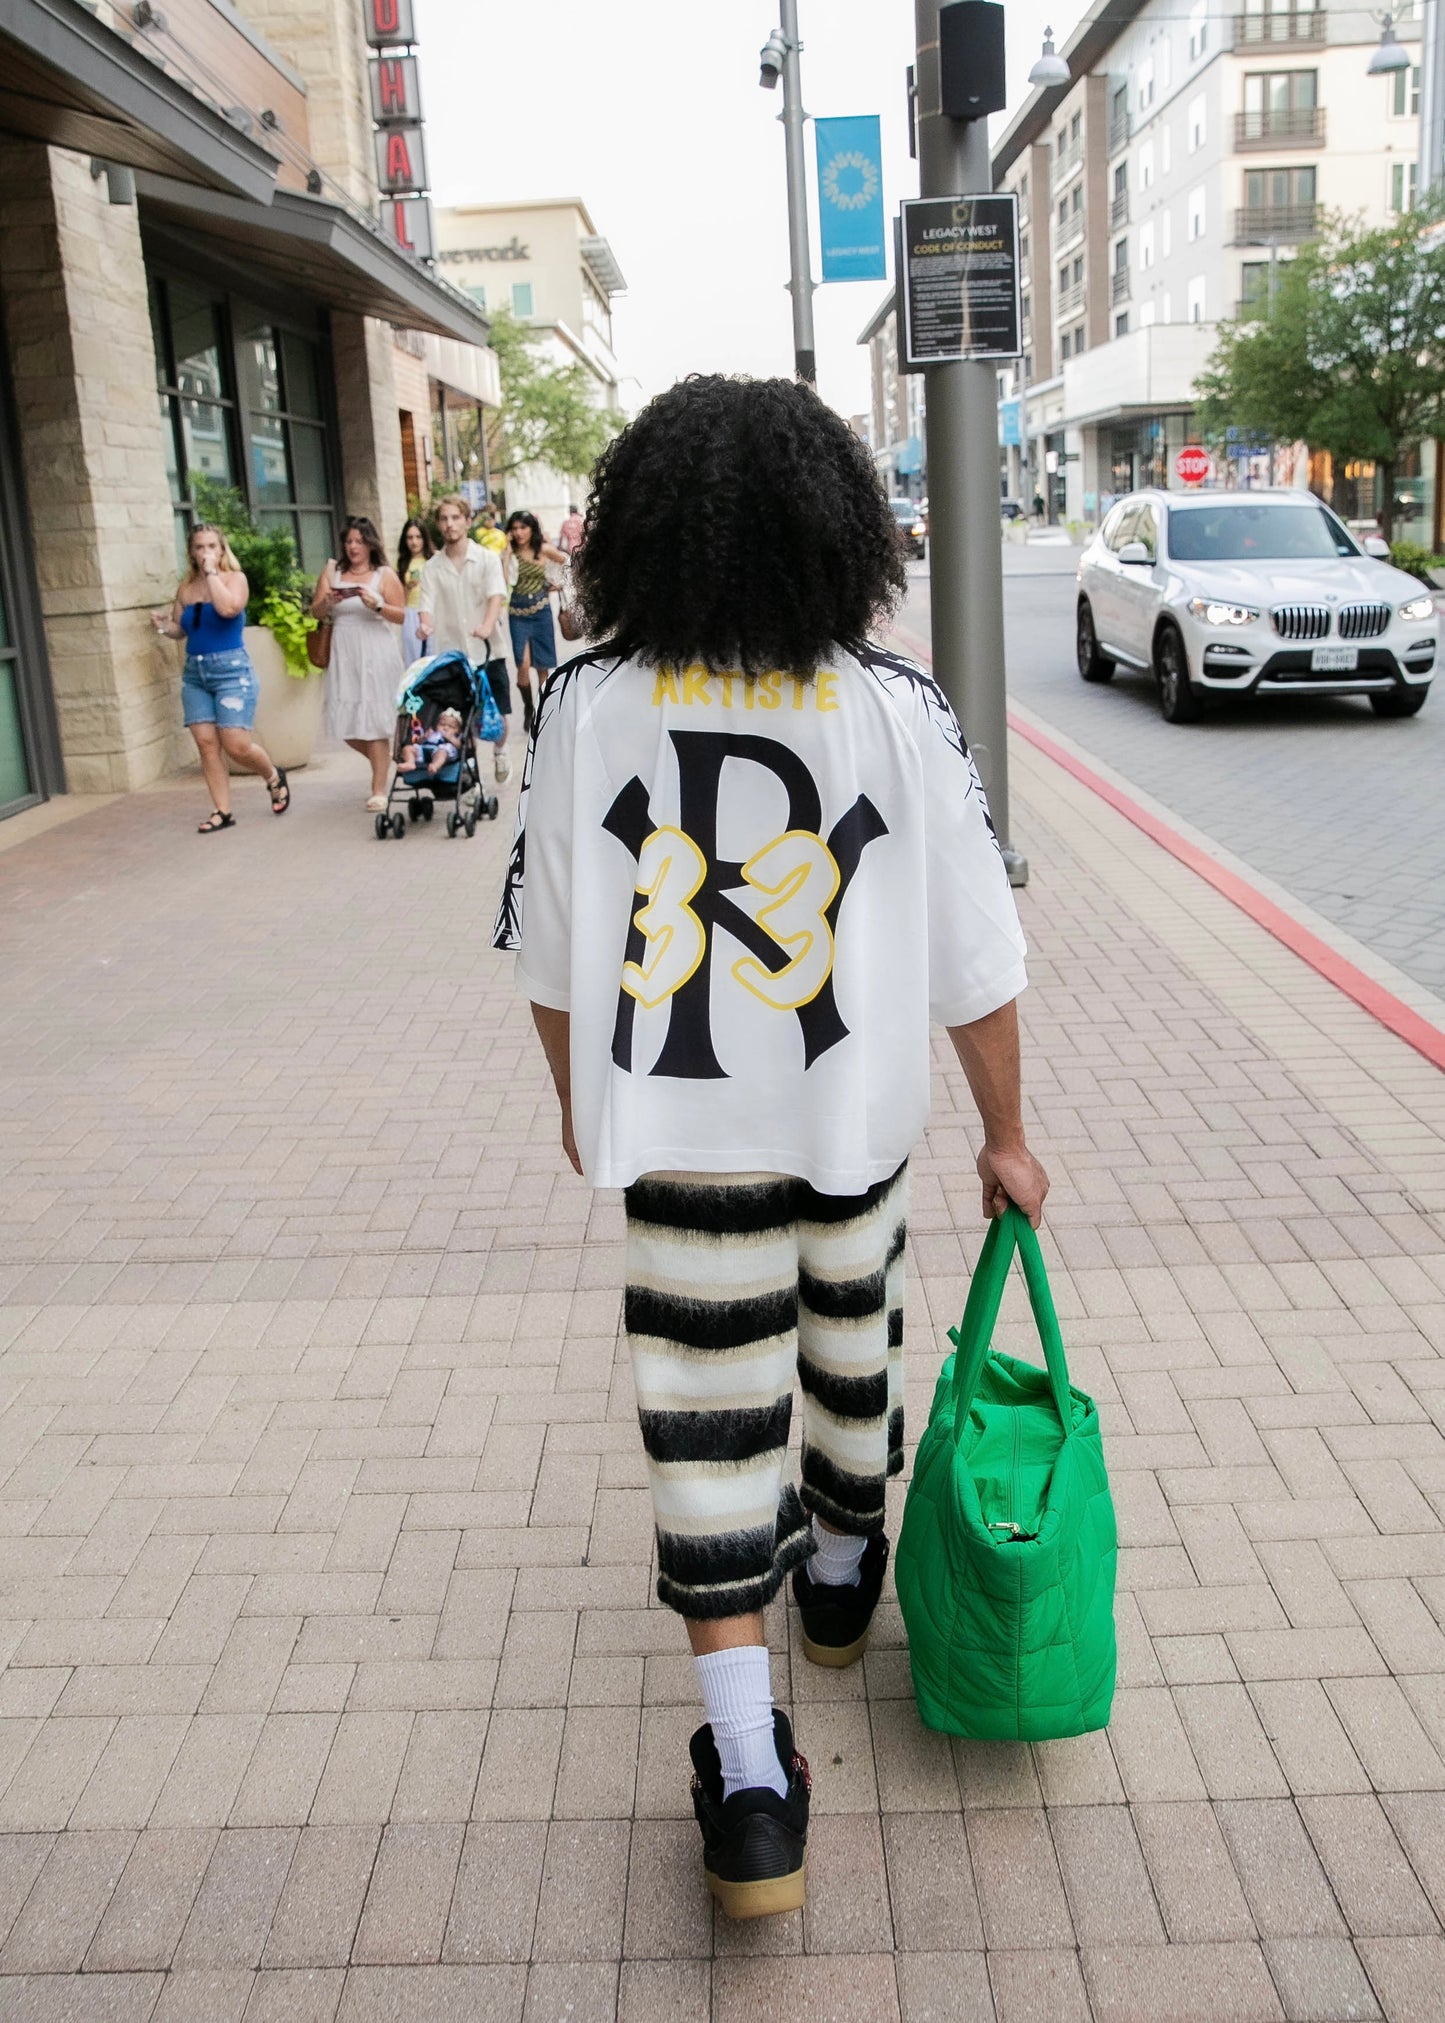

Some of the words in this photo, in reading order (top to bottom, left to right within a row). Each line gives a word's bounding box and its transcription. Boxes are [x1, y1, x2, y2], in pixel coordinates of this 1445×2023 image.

[922, 226, 966, 240] LEGACY
[968, 224, 998, 237] WEST
[913, 243, 940, 255] CODE
[942, 242, 955, 253] OF
[956, 239, 1004, 251] CONDUCT
[1175, 456, 1208, 474] STOP
[652, 664, 840, 712] ARTISTE
